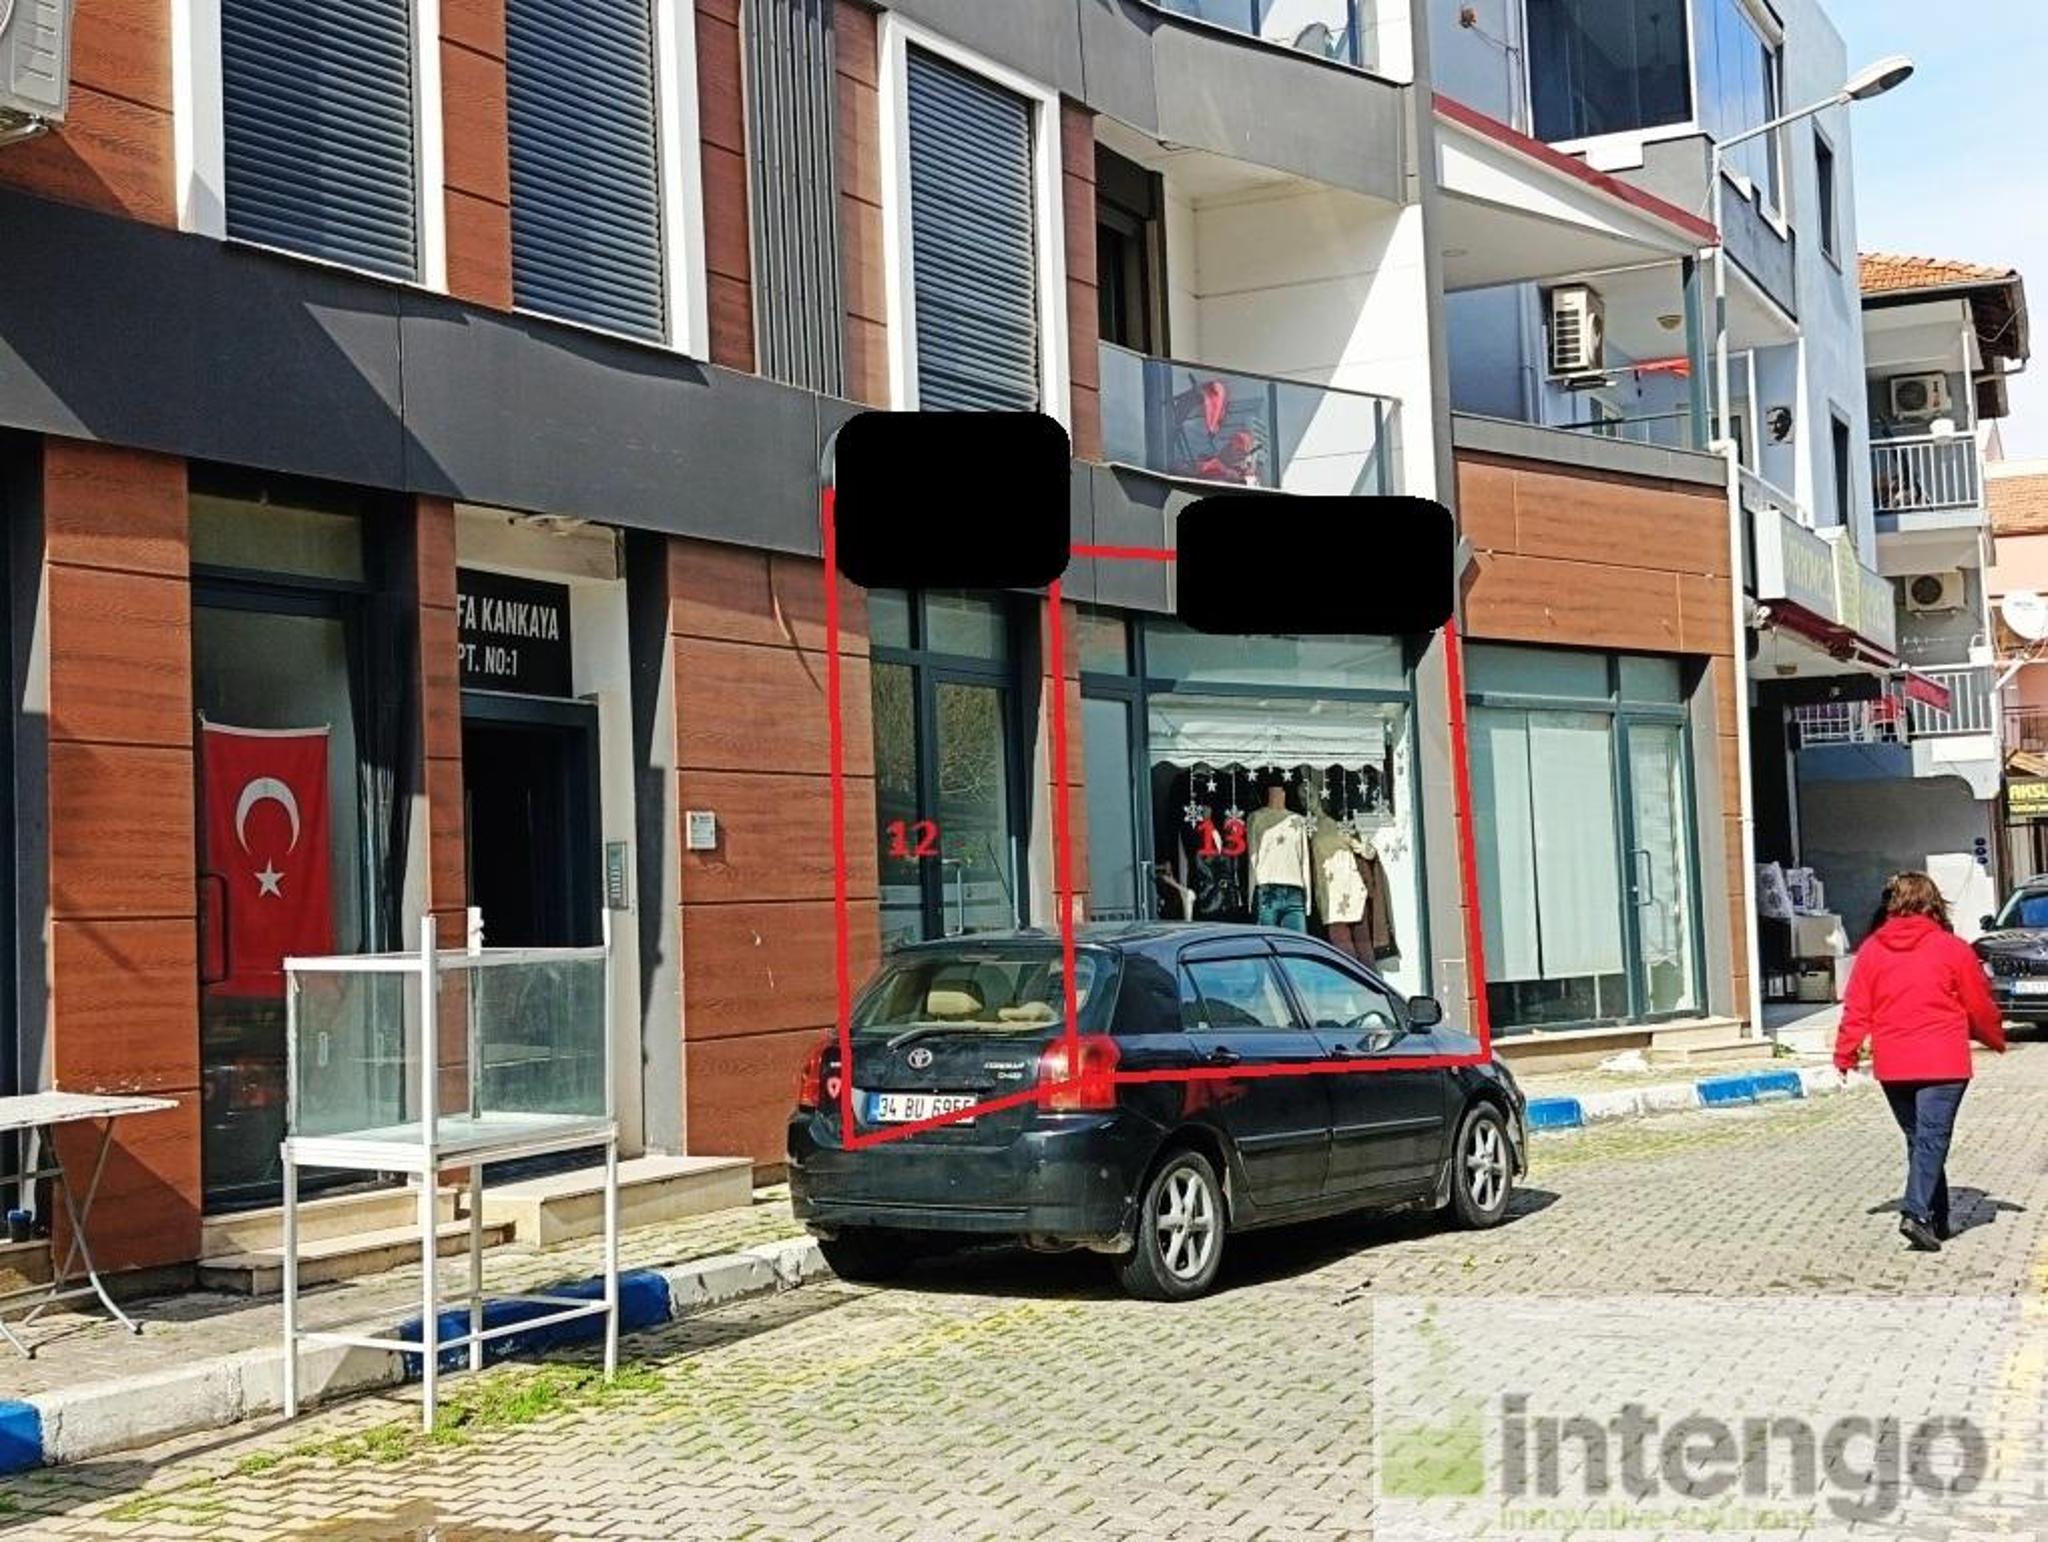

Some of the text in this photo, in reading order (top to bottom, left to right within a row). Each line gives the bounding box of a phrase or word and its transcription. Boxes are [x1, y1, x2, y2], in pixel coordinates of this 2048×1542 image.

[481, 597, 559, 640] KANKAYA
[485, 645, 517, 676] NO:1
[879, 1098, 897, 1117] 34
[905, 1098, 924, 1119] BU
